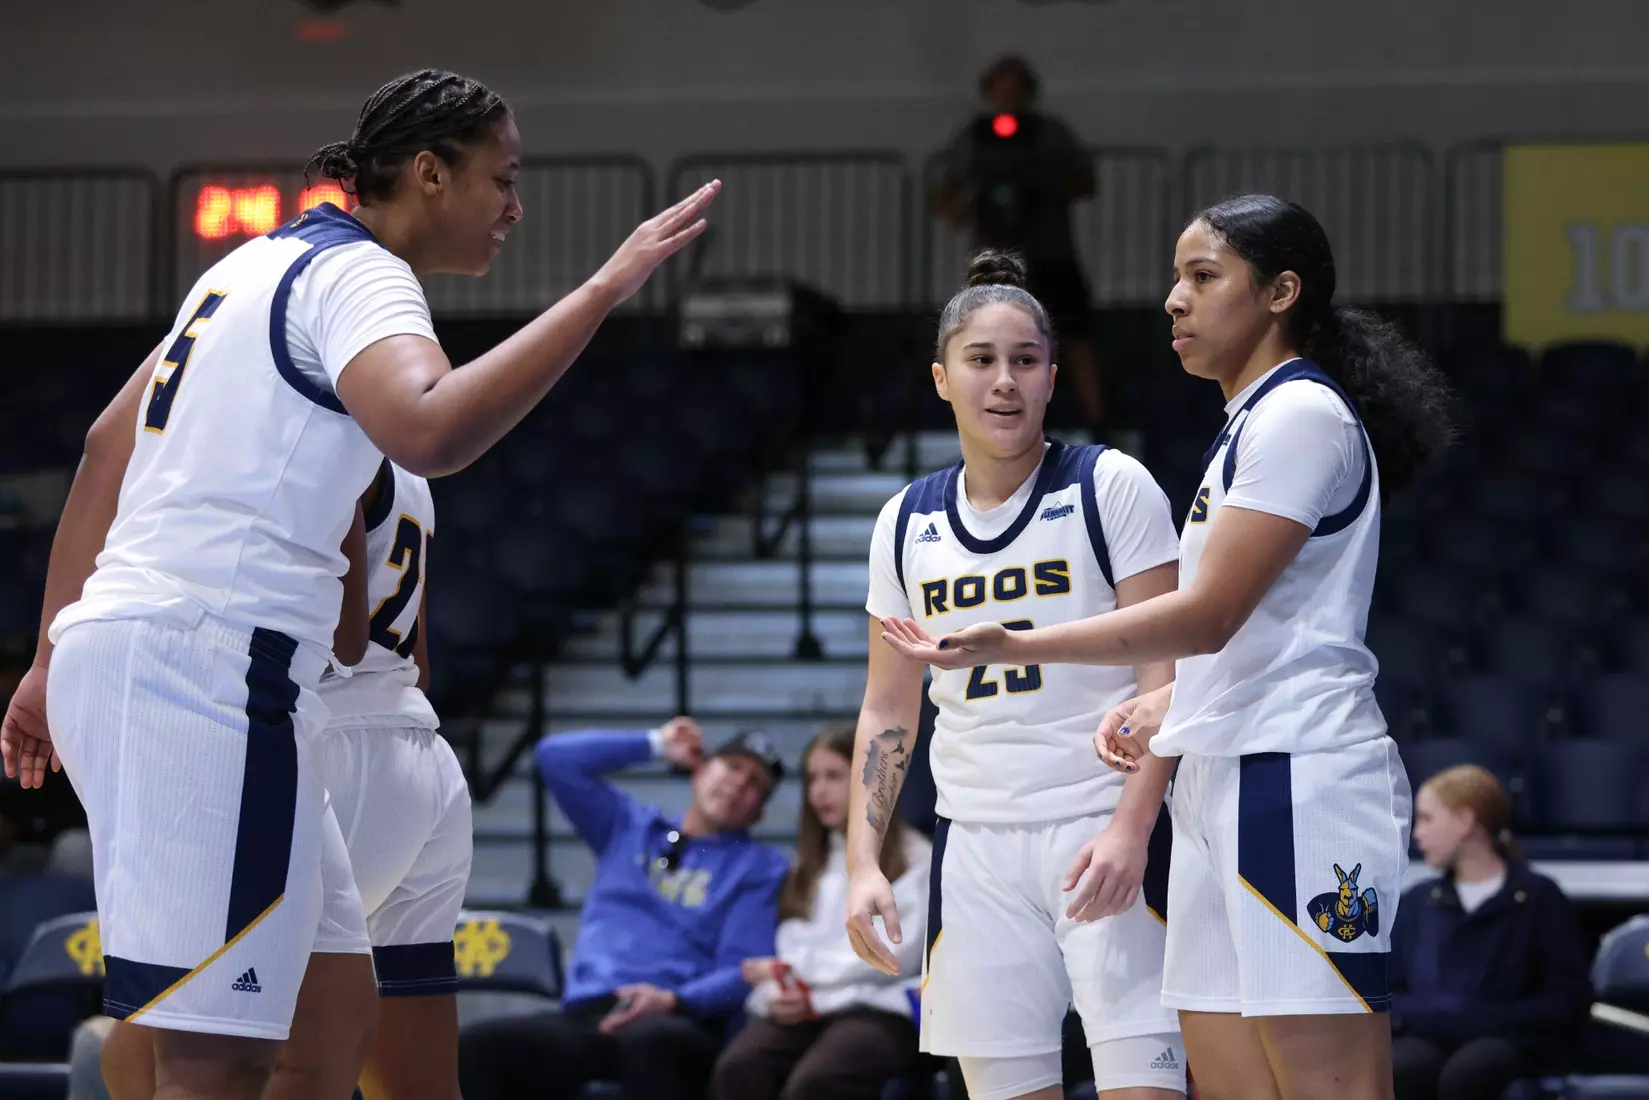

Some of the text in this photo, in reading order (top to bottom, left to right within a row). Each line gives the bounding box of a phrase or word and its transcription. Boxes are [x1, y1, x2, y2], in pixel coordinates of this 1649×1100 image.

[143, 287, 231, 436] 5
[919, 557, 1073, 619] ROOS
[231, 981, 262, 994] adidas
